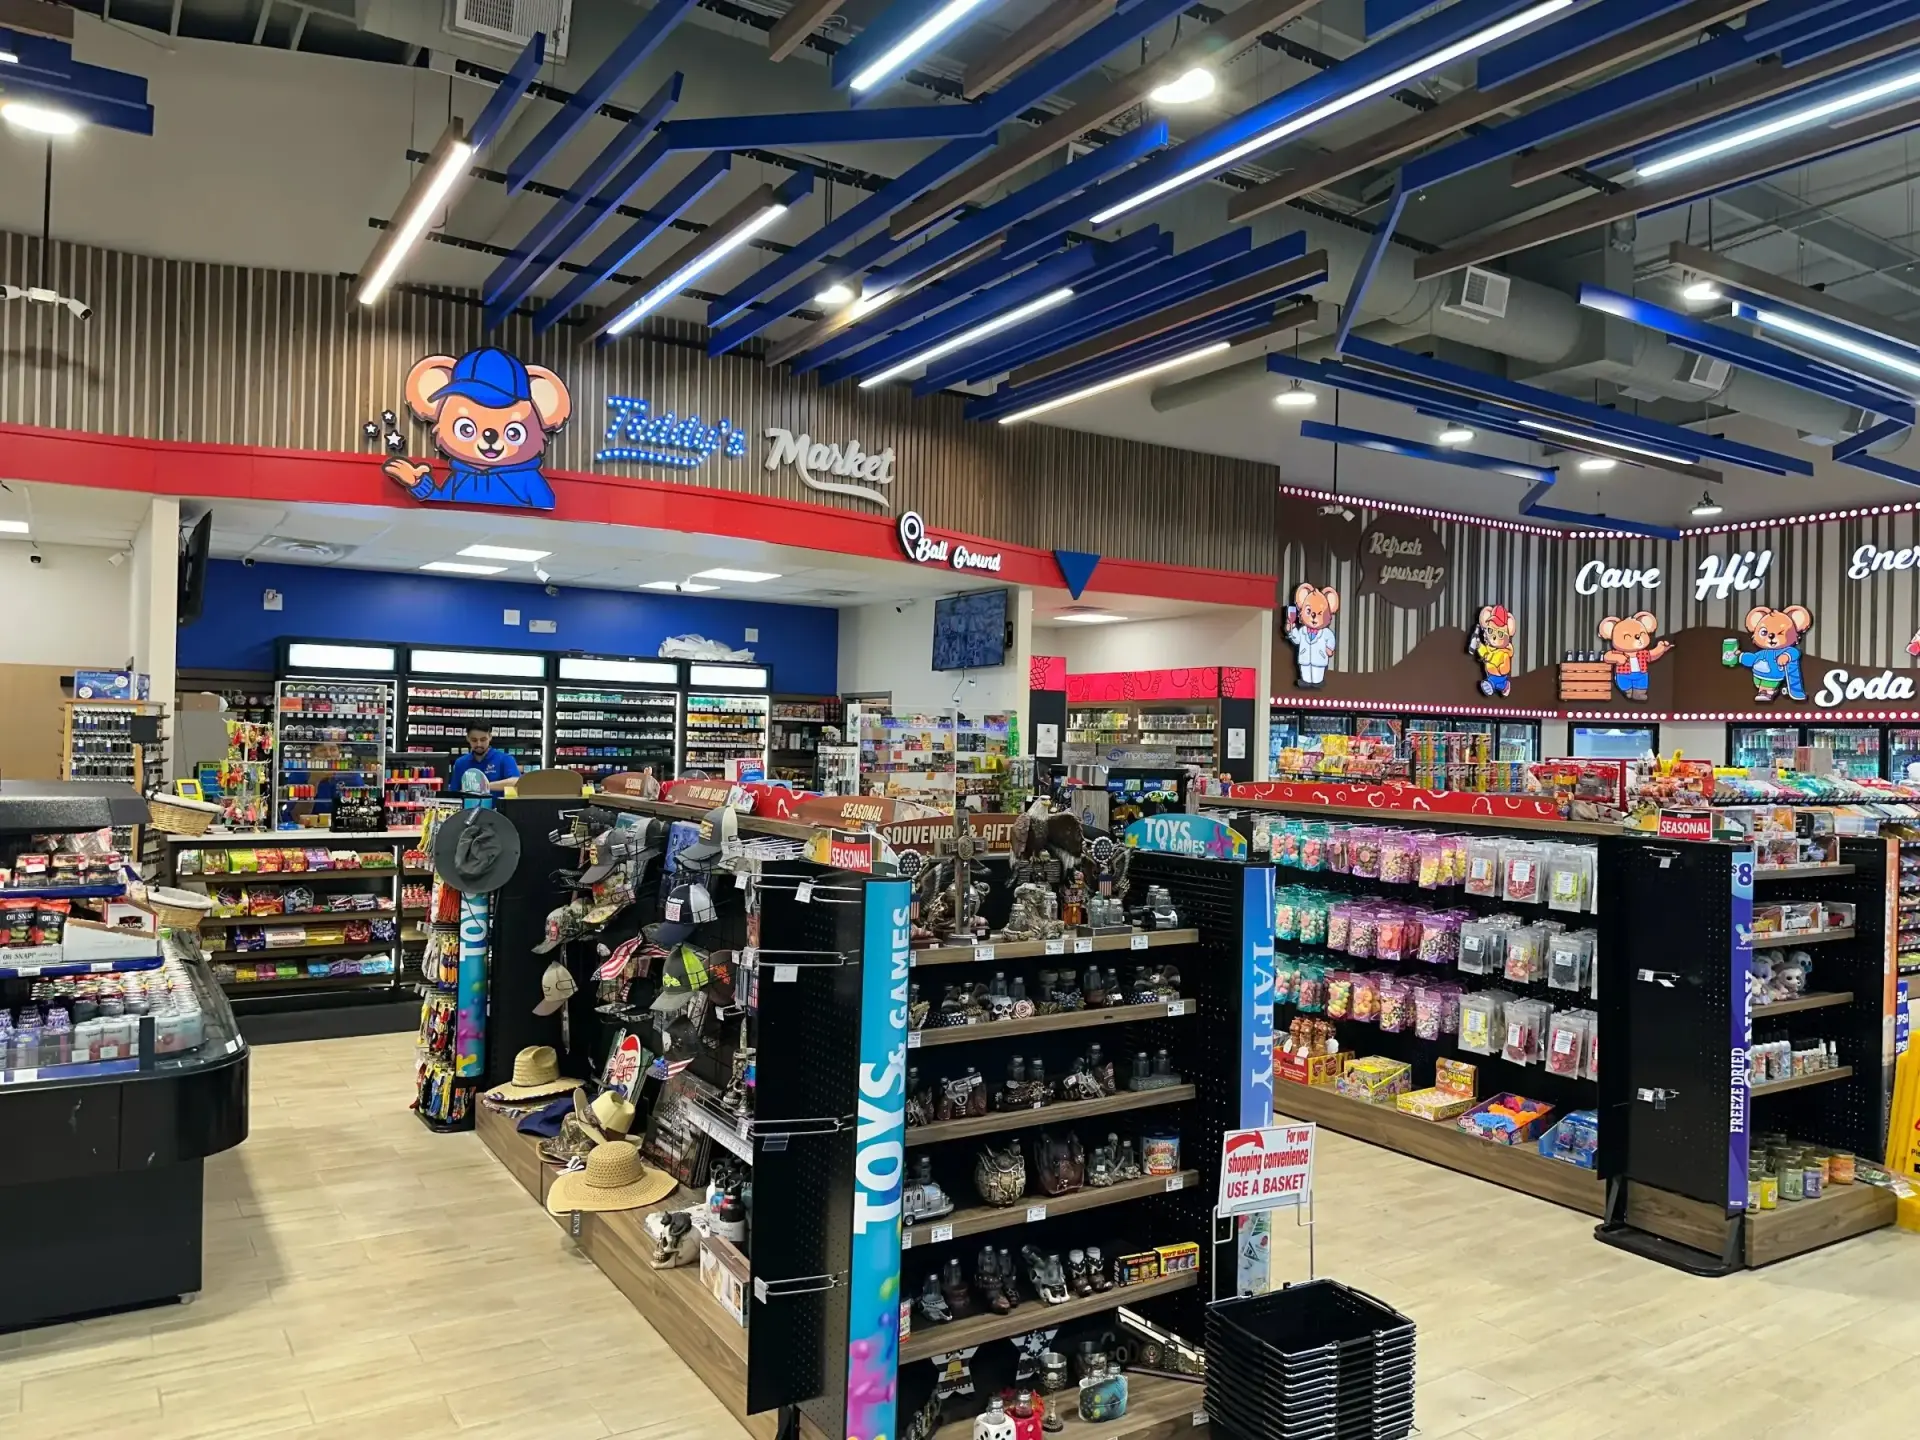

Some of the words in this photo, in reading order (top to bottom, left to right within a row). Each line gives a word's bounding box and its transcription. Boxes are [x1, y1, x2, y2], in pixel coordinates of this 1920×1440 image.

[595, 396, 748, 469] Teddy's
[765, 427, 895, 506] Market
[916, 535, 948, 562] Ball
[953, 545, 1001, 572] Ground
[1368, 532, 1423, 557] Refresh
[1379, 565, 1445, 588] yourself?
[1575, 560, 1661, 595] Cave
[1694, 550, 1772, 601] Hi!
[1814, 669, 1914, 707] Soda
[840, 802, 884, 822] SEASONAL
[1661, 820, 1710, 834] SEASONAL
[883, 824, 955, 845] SOUVENIR
[1145, 818, 1191, 843] TOYS
[832, 847, 870, 868] SEASONAL
[1169, 839, 1205, 854] GAMES
[1252, 936, 1274, 1098] TAFFY
[856, 1062, 906, 1234] TOYS
[889, 905, 910, 1028] GAMES
[1731, 1047, 1745, 1086] DRIED
[1730, 1087, 1745, 1133] FREEZE
[1286, 1129, 1296, 1144] For
[1297, 1129, 1310, 1145] your
[1228, 1151, 1263, 1177] shopping
[1264, 1147, 1309, 1170] convenience
[1227, 1180, 1249, 1198] USE
[1251, 1179, 1260, 1195] A
[1263, 1173, 1306, 1194] BASKET
